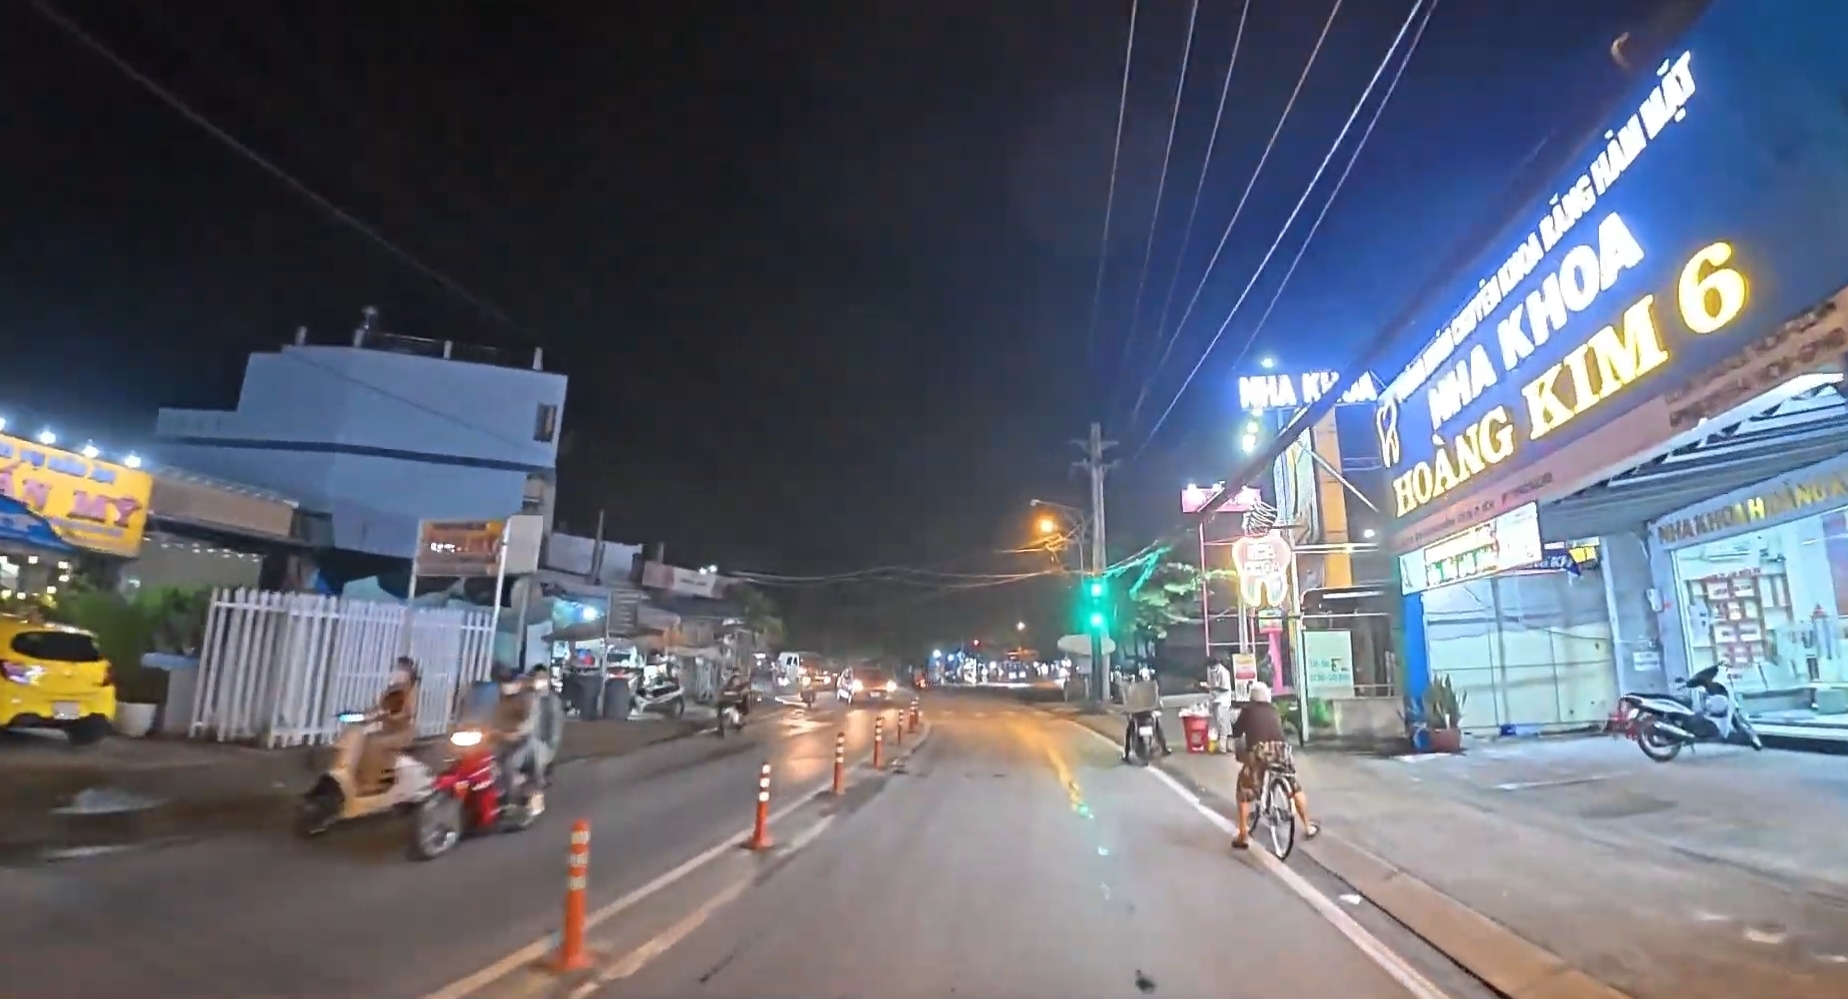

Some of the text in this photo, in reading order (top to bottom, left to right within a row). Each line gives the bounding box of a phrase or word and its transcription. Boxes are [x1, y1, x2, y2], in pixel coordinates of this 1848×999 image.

[1239, 374, 1297, 409] NHA
[1392, 404, 1514, 518] HOÀNG
[1521, 294, 1669, 440] KIM
[1678, 241, 1747, 334] 6
[1428, 344, 1498, 430] NHA
[1497, 212, 1645, 371] KHOA
